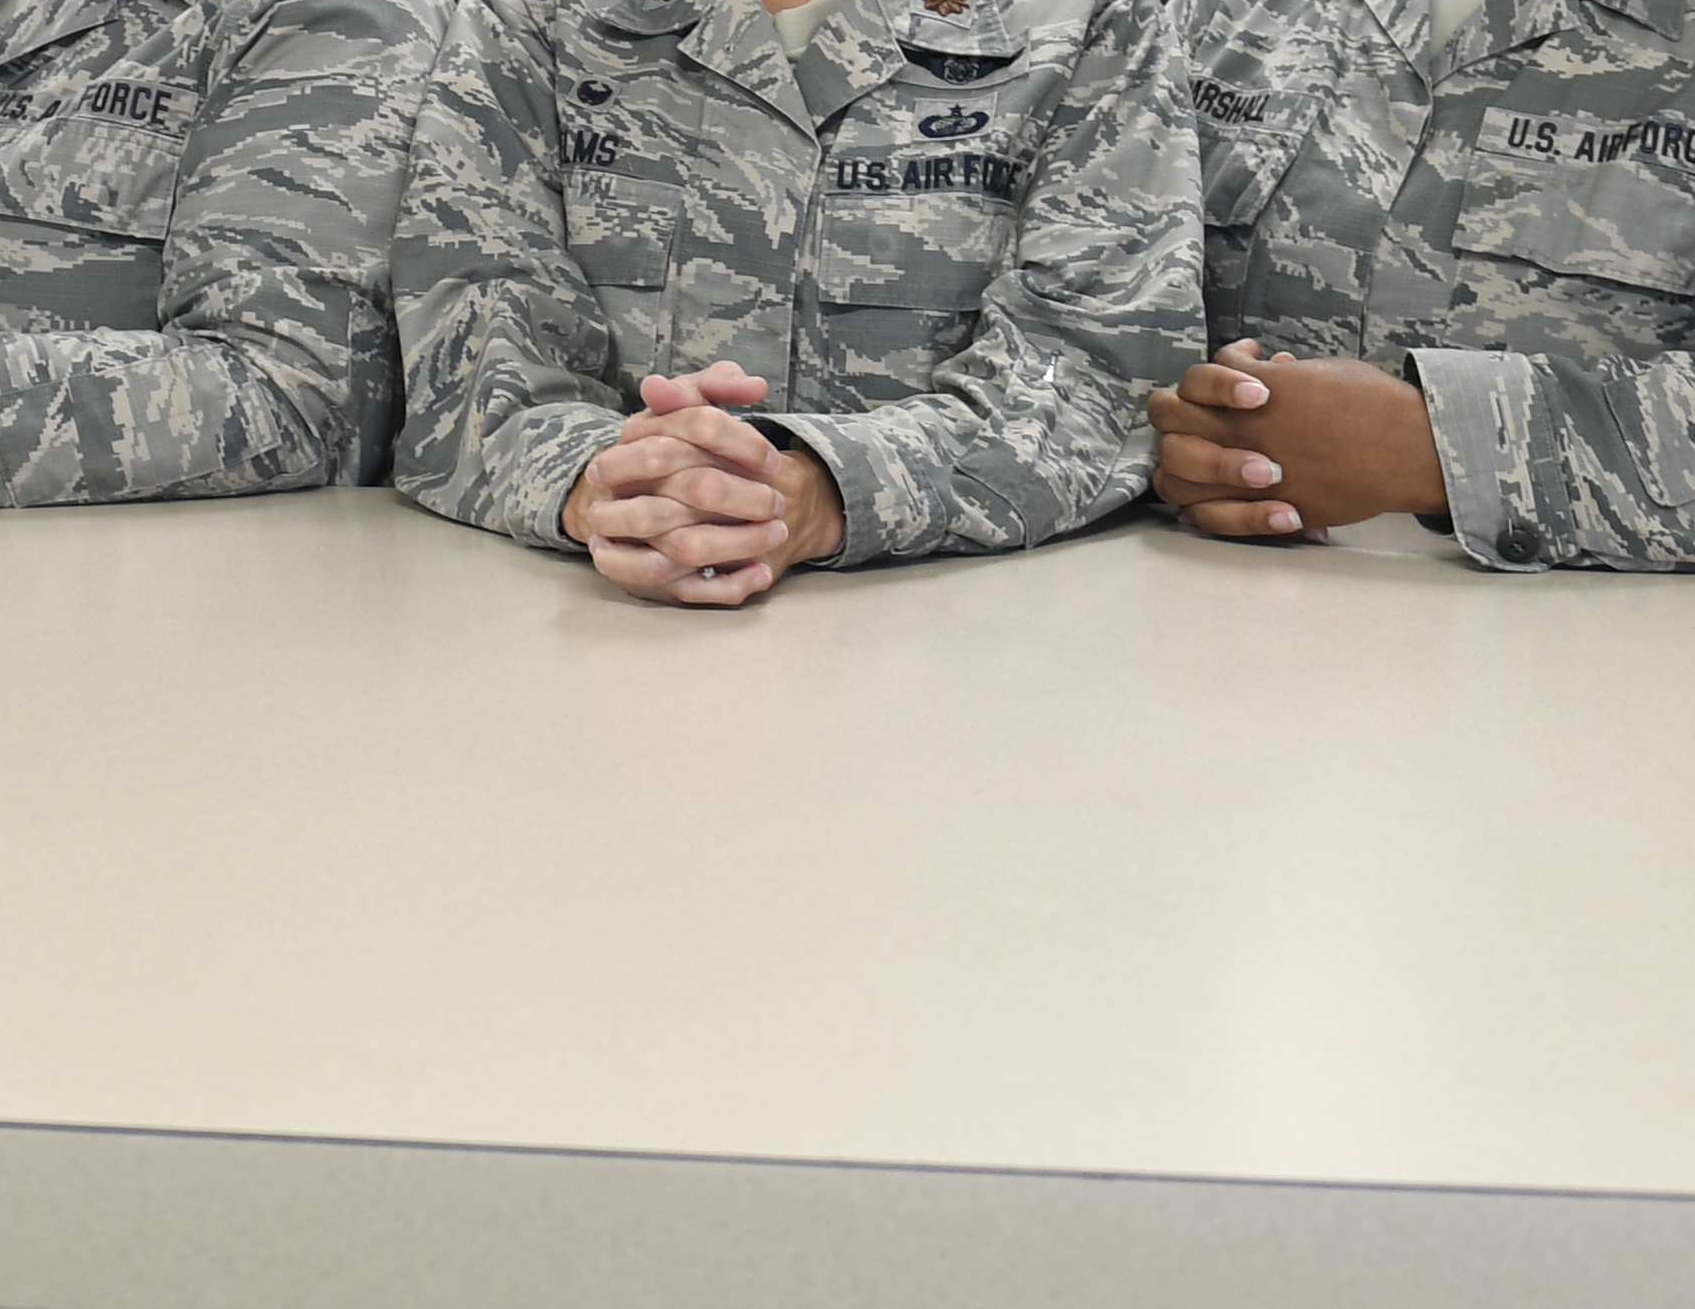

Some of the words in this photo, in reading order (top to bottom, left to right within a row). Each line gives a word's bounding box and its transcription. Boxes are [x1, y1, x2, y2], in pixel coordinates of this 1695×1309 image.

[76, 81, 172, 125] FORCE
[1508, 117, 1561, 156] U.S.
[1574, 131, 1624, 163] AIR
[837, 160, 891, 190] U.S.
[903, 157, 954, 189] AIR
